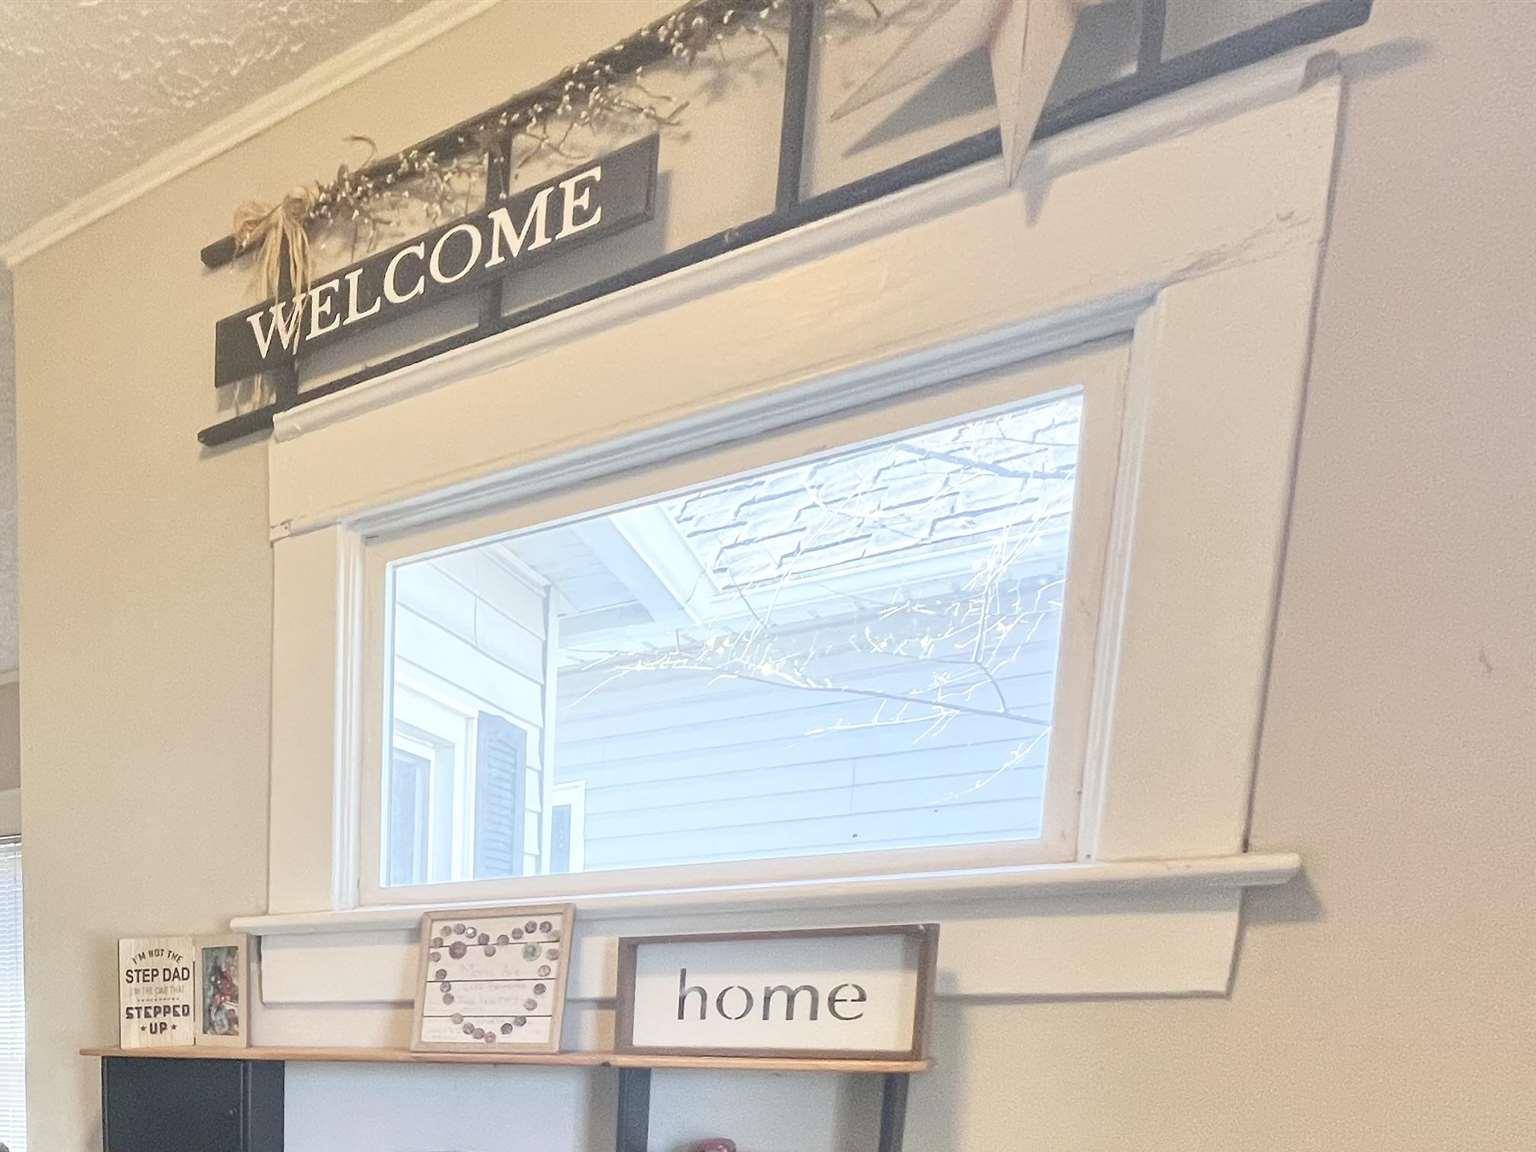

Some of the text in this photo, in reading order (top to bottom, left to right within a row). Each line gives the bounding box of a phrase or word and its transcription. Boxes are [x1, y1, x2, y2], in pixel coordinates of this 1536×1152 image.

[246, 165, 602, 360] WELCOME
[148, 949, 164, 958] NOT
[167, 950, 183, 963] THE
[125, 967, 190, 984] STEP DAD
[677, 968, 868, 1021] home
[125, 1004, 190, 1019] STEPPED
[149, 1022, 168, 1034] UP
